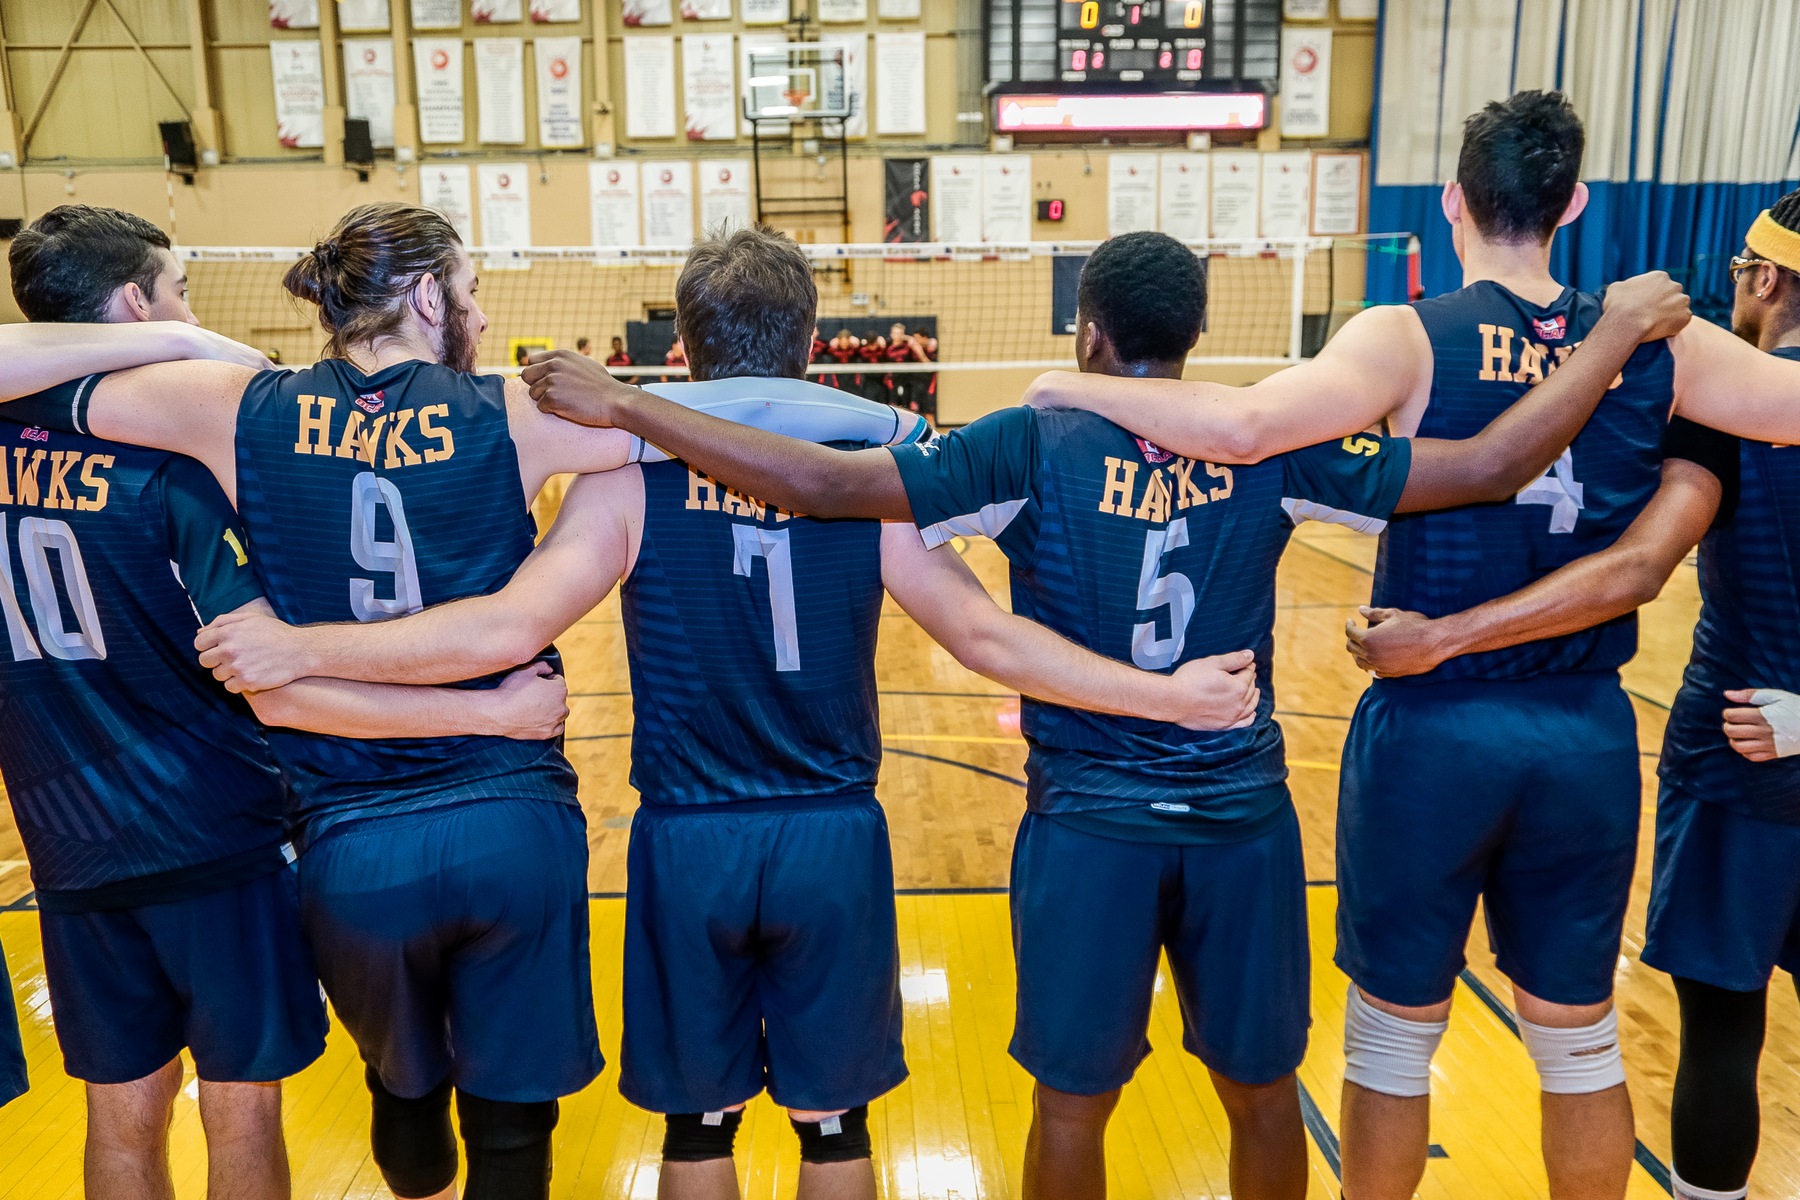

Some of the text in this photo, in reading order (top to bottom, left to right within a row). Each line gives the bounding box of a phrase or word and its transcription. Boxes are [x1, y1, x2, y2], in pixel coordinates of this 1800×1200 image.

[1080, 1, 1099, 29] 0
[1184, 1, 1203, 29] 0
[1072, 50, 1086, 71] 0
[1187, 49, 1202, 70] 0
[1049, 200, 1063, 220] 0
[294, 394, 455, 469] HAWKS
[1342, 436, 1380, 456] 5
[1516, 446, 1584, 533] 4
[223, 527, 249, 567] 1
[349, 471, 423, 623] 9
[0, 512, 107, 661] 10
[731, 523, 801, 672] 7
[1131, 517, 1196, 670] 5
